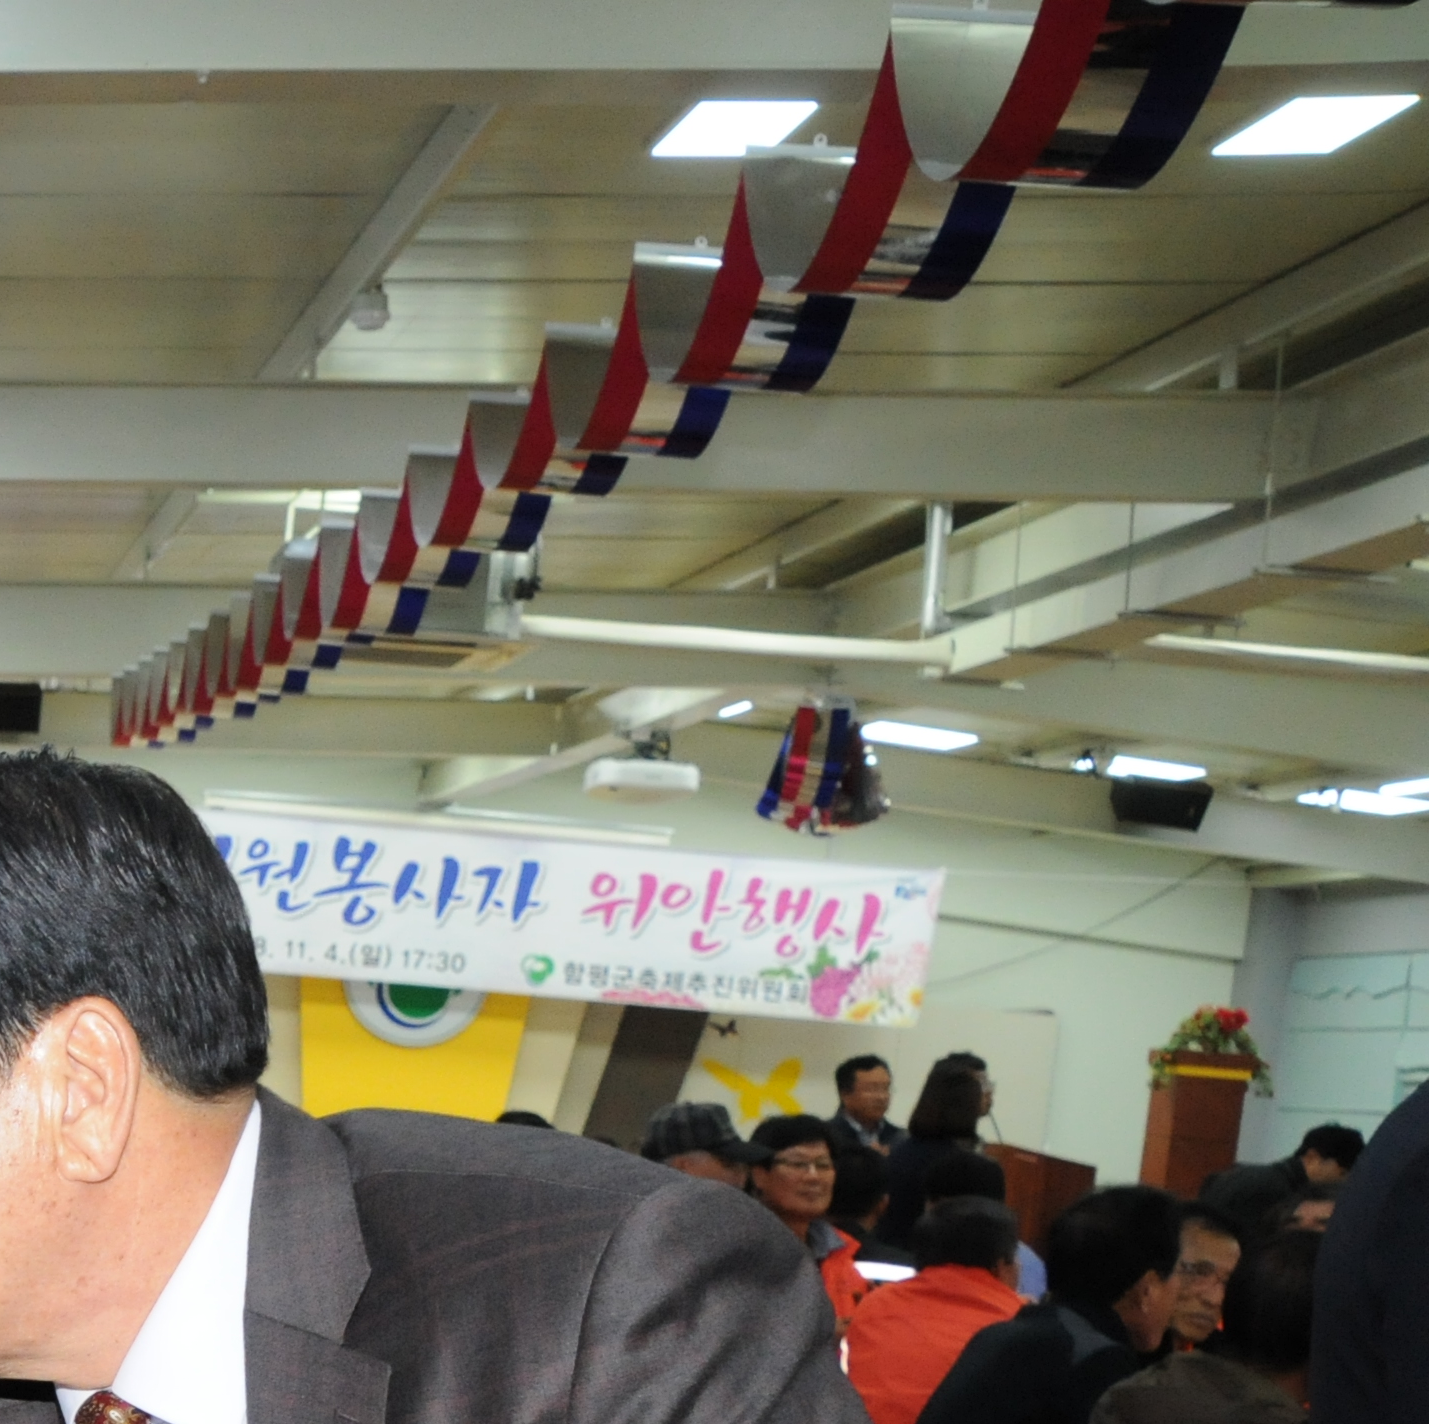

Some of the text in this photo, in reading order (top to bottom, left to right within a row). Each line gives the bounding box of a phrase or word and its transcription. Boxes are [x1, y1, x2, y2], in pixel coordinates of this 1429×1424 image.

[215, 834, 887, 959] 원봉사자 위안행사
[402, 950, 467, 974] 17:30
[563, 961, 811, 1005] 함평군축제추진위원회
